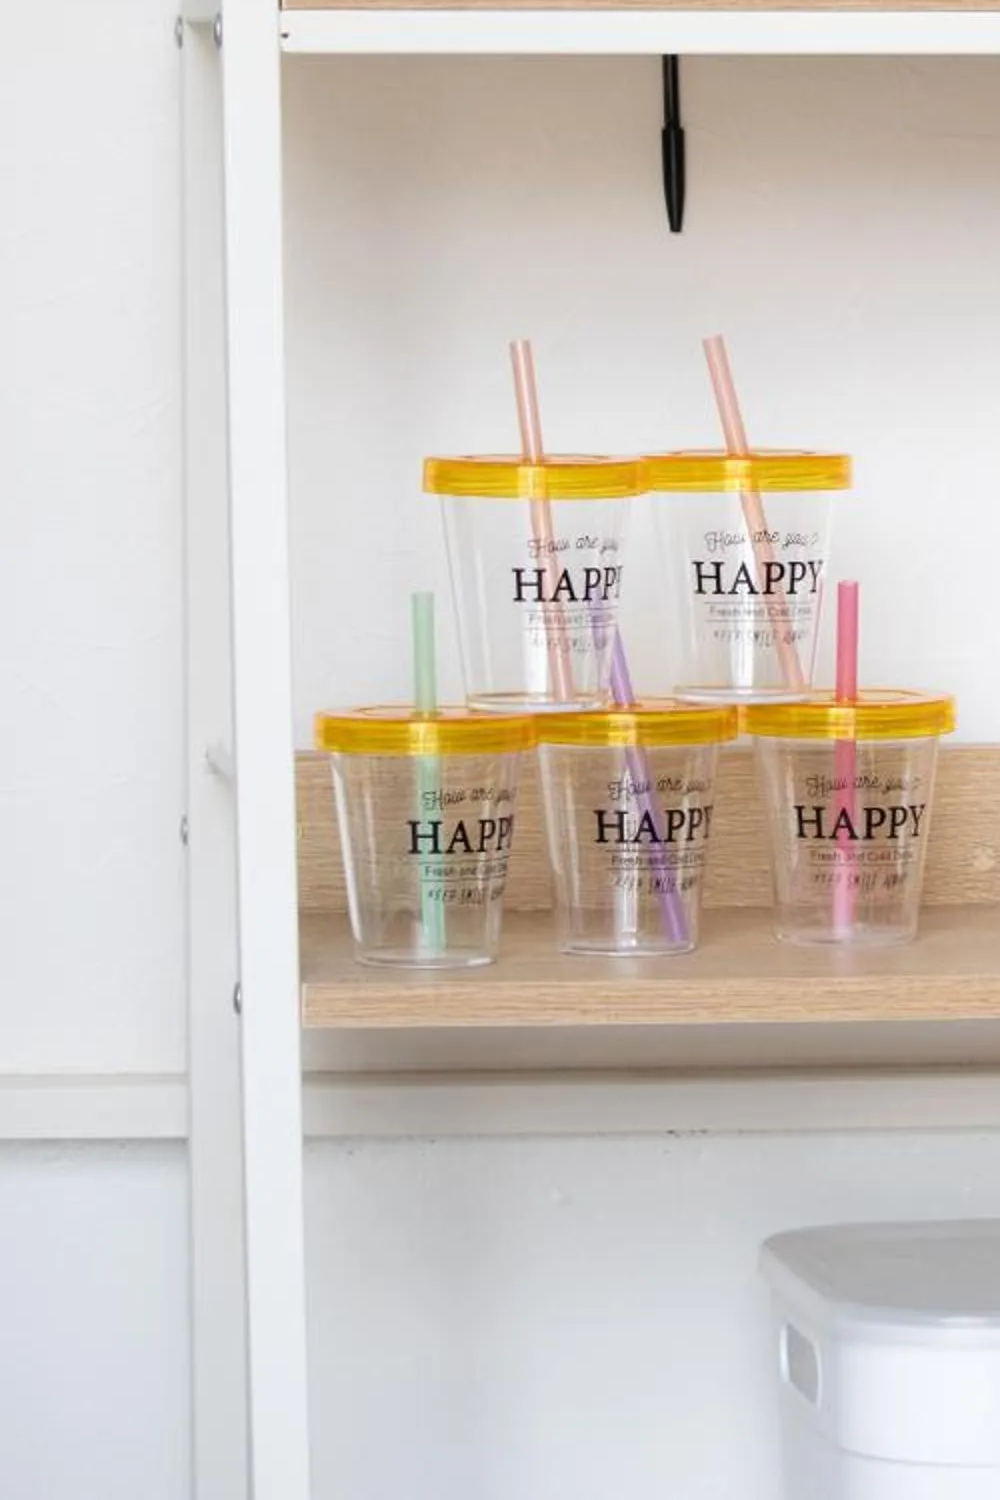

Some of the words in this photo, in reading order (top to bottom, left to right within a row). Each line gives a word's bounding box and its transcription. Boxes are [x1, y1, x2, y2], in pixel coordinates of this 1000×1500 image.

[691, 560, 823, 594] HAPPY
[593, 805, 714, 843] HAPPY
[794, 804, 926, 840] HAPPY
